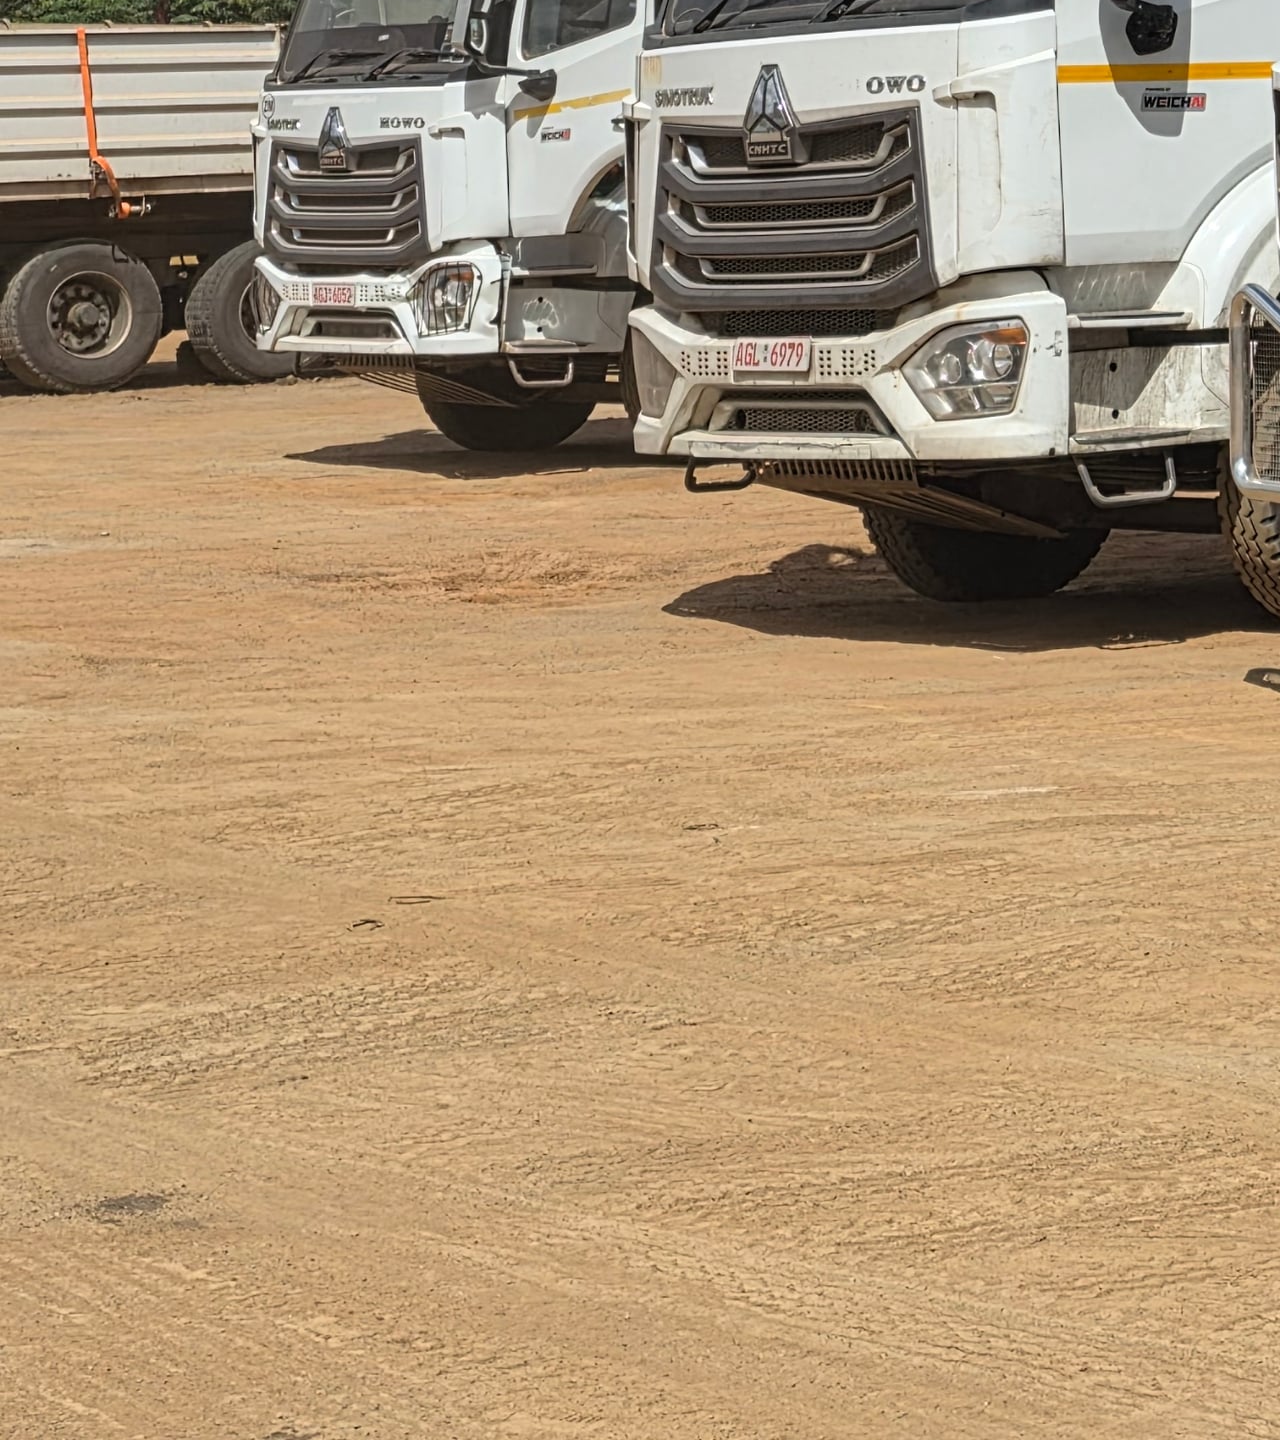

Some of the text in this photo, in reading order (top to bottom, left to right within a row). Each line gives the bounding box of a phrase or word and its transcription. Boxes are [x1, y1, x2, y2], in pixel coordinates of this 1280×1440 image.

[1144, 96, 1205, 109] WEICHAI
[380, 117, 425, 128] HOWO
[749, 143, 787, 155] CNHTC
[736, 342, 804, 367] AGL 6979
